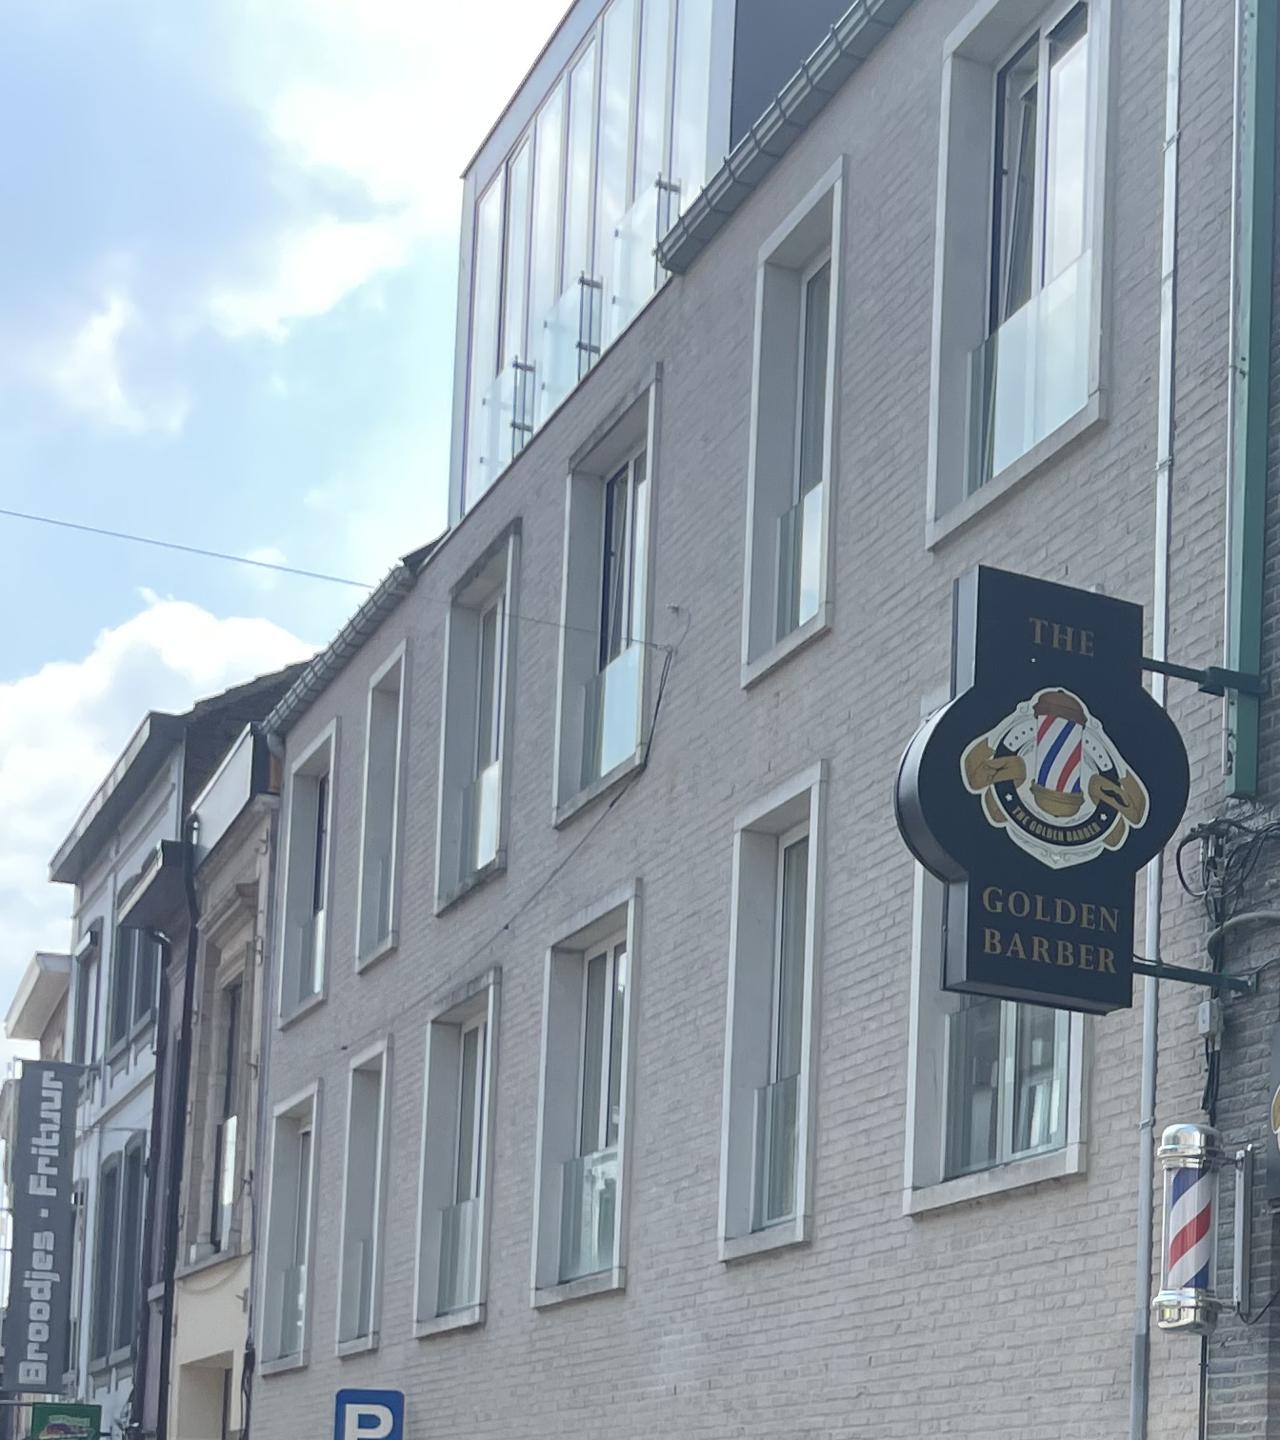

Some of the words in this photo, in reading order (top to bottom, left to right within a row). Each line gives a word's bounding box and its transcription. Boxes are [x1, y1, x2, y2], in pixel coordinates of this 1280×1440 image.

[1028, 617, 1095, 657] THE
[1012, 806, 1030, 826] THE
[1029, 820, 1065, 841] GOLDEN
[982, 886, 1120, 932] GOLDEN
[984, 928, 1117, 974] BARBER
[29, 1070, 64, 1196] Frituur
[18, 1230, 61, 1386] Broodjes
